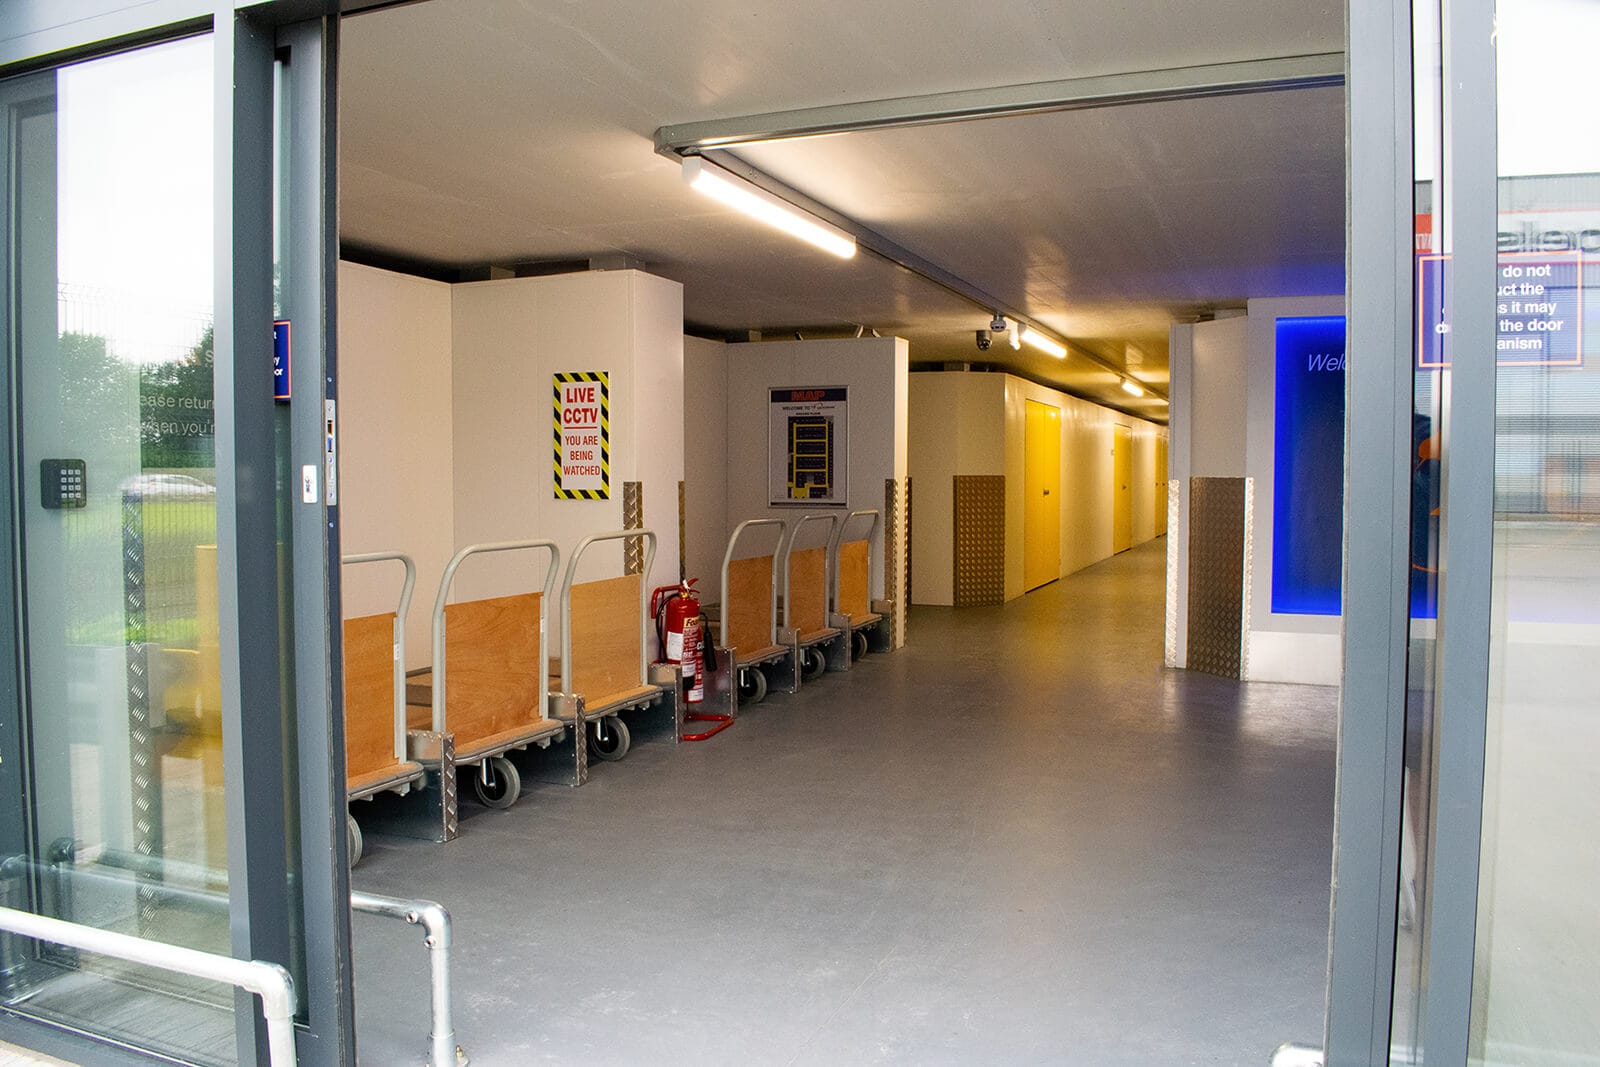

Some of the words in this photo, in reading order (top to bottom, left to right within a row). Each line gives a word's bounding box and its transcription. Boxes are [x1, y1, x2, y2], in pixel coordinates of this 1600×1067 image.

[1502, 265, 1522, 278] do
[1526, 264, 1552, 277] not
[1520, 282, 1544, 296] the
[1512, 301, 1521, 313] it
[1525, 302, 1557, 316] may
[1500, 319, 1523, 332] the
[1527, 319, 1564, 332] door
[566, 387, 595, 404] LIVE
[791, 390, 825, 401] MAP
[178, 396, 215, 409] retur
[563, 407, 598, 424] CCTV
[565, 435, 581, 445] YOU
[583, 435, 598, 445] ARE
[570, 450, 593, 461] BEING
[563, 465, 600, 476] WATCHED
